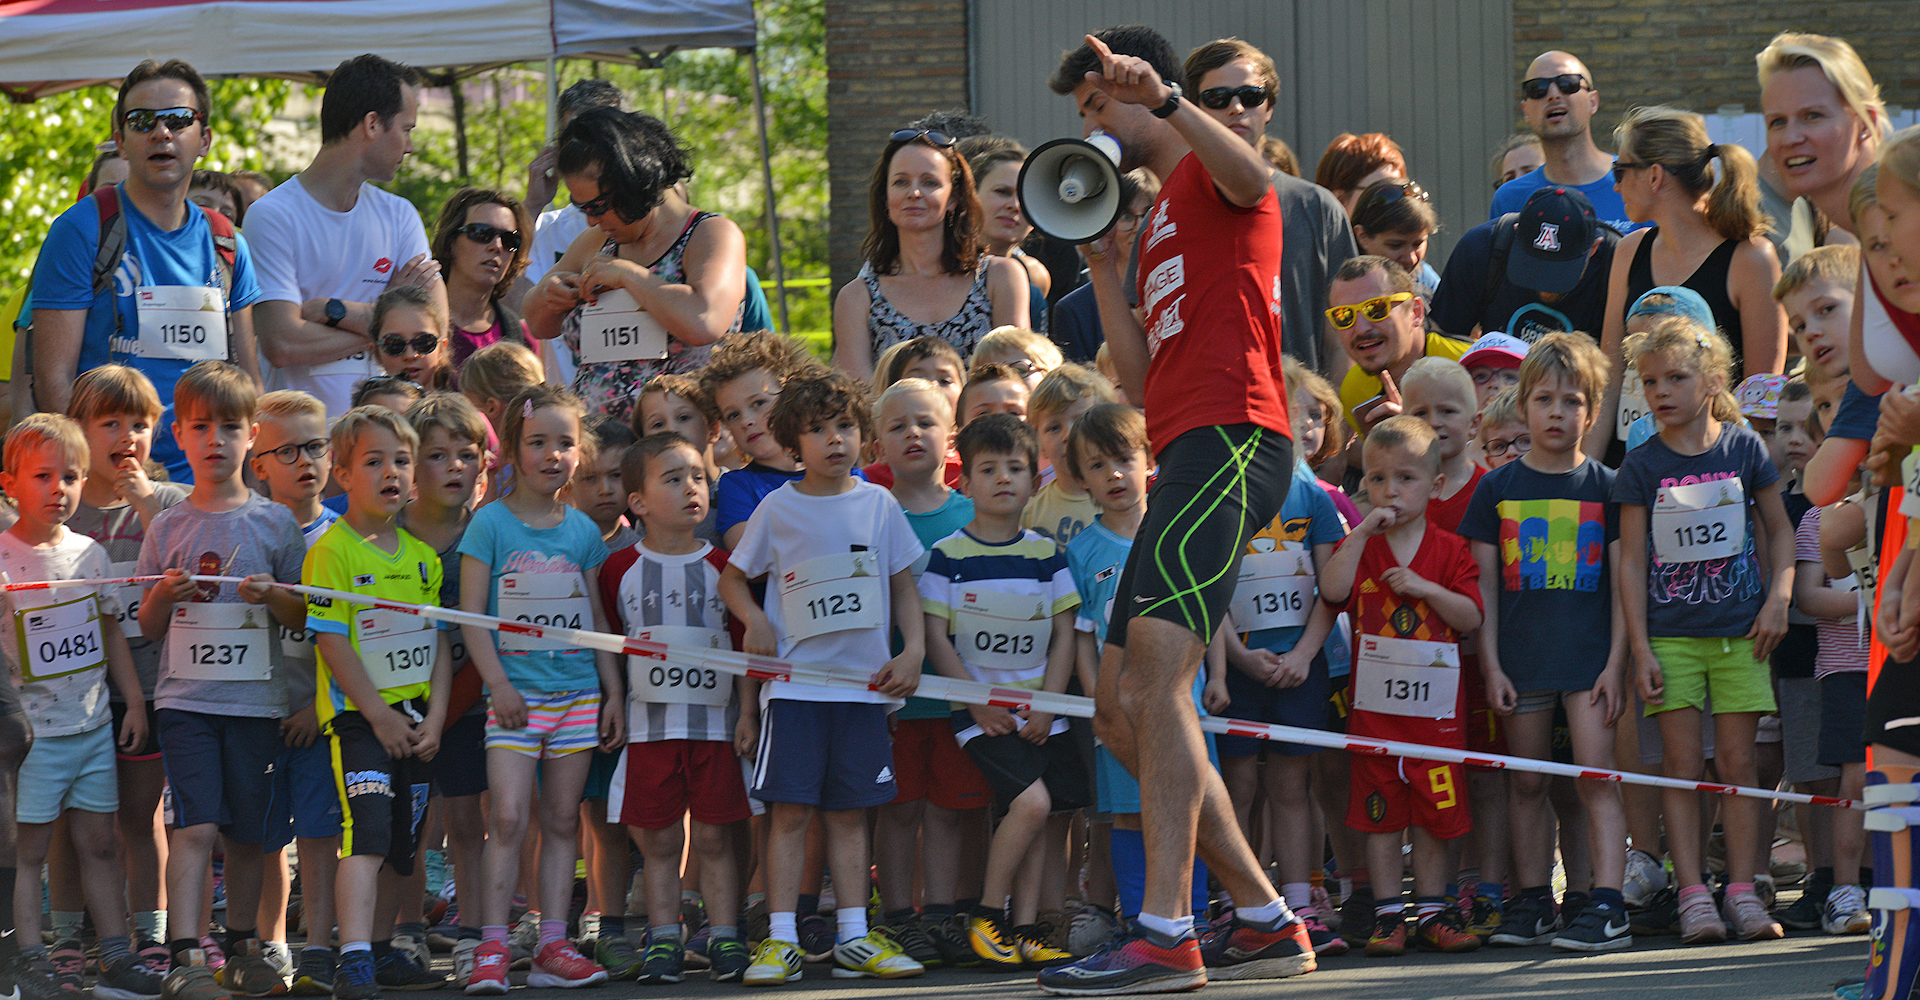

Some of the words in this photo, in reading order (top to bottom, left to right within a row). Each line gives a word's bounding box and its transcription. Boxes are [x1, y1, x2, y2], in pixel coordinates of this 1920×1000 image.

[160, 324, 206, 344] 1150
[601, 325, 639, 347] 1151
[1674, 521, 1728, 547] 1132
[807, 593, 862, 619] 1123
[1252, 590, 1302, 615] 1316
[40, 630, 99, 663] 0481
[975, 630, 1034, 654] 0213
[189, 644, 249, 665] 1237
[385, 645, 431, 672] 1307
[649, 666, 717, 689] 0903
[1384, 679, 1430, 701] 1311
[1428, 764, 1457, 810] 9
